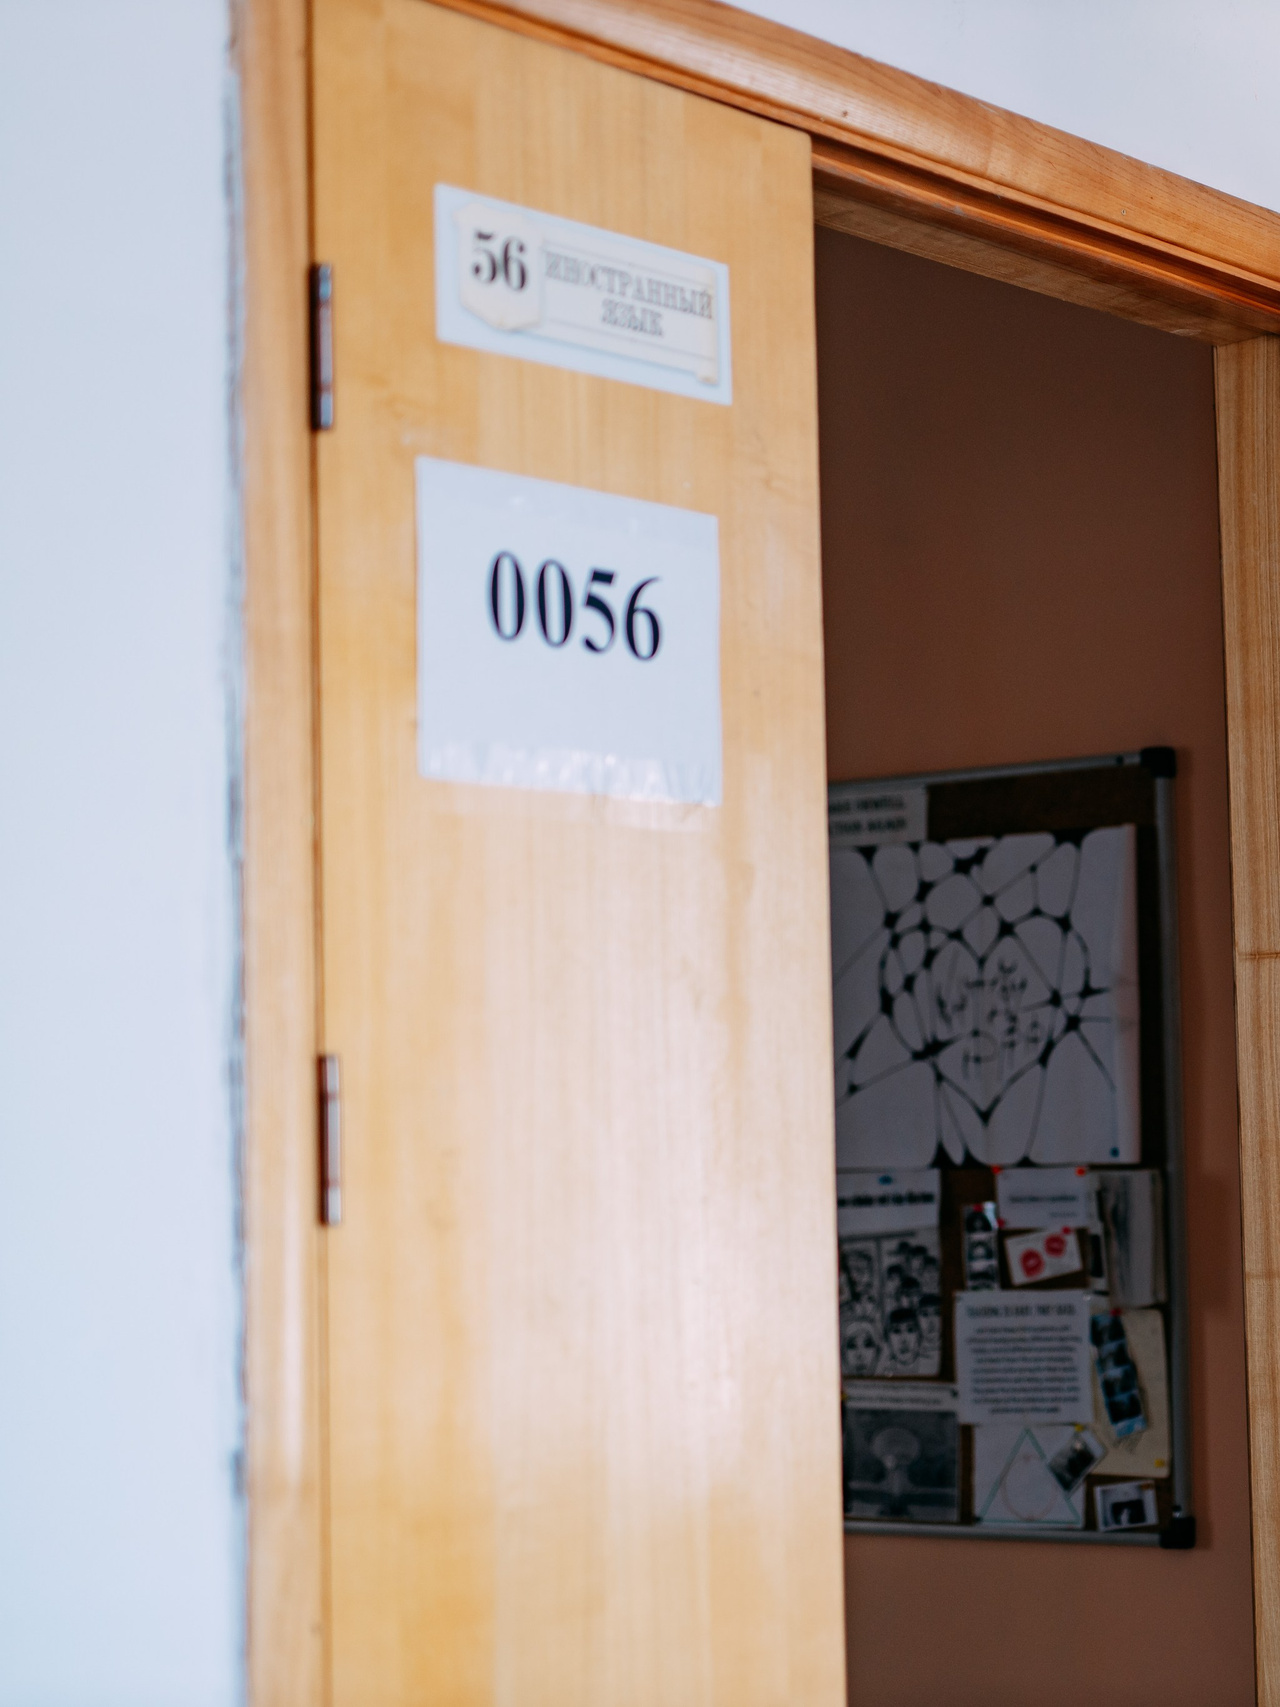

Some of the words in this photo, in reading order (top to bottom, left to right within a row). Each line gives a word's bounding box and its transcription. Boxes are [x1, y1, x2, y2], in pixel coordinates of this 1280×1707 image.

[473, 229, 527, 291] 56
[546, 251, 713, 320] ИНОСТРАННЫЙ
[601, 301, 664, 337] ЯЗЫК
[488, 550, 663, 661] 0056
